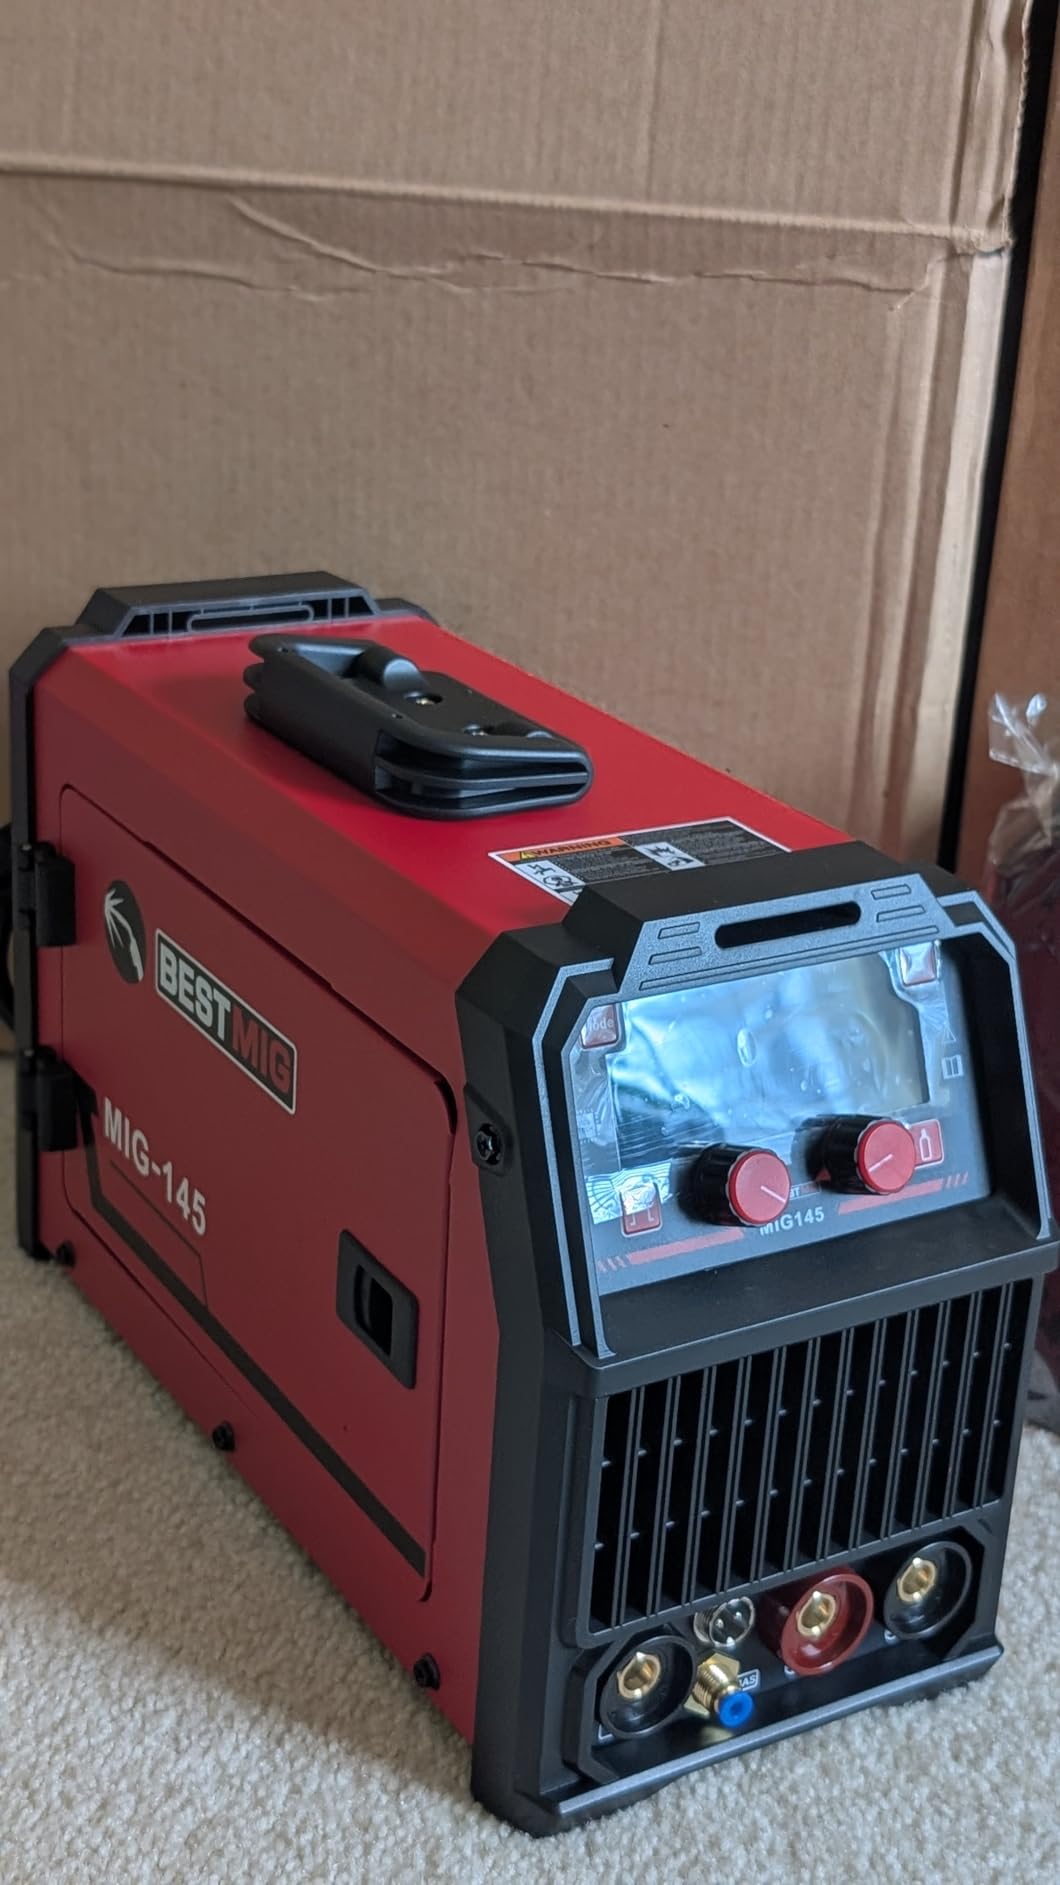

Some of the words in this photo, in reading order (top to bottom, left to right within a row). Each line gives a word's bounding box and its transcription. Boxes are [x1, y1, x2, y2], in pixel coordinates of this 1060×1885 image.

[534, 839, 612, 856] WARNING
[104, 1096, 207, 1236] MIG-145
[760, 1206, 825, 1237] MIG145
[739, 1674, 757, 1688] AS
